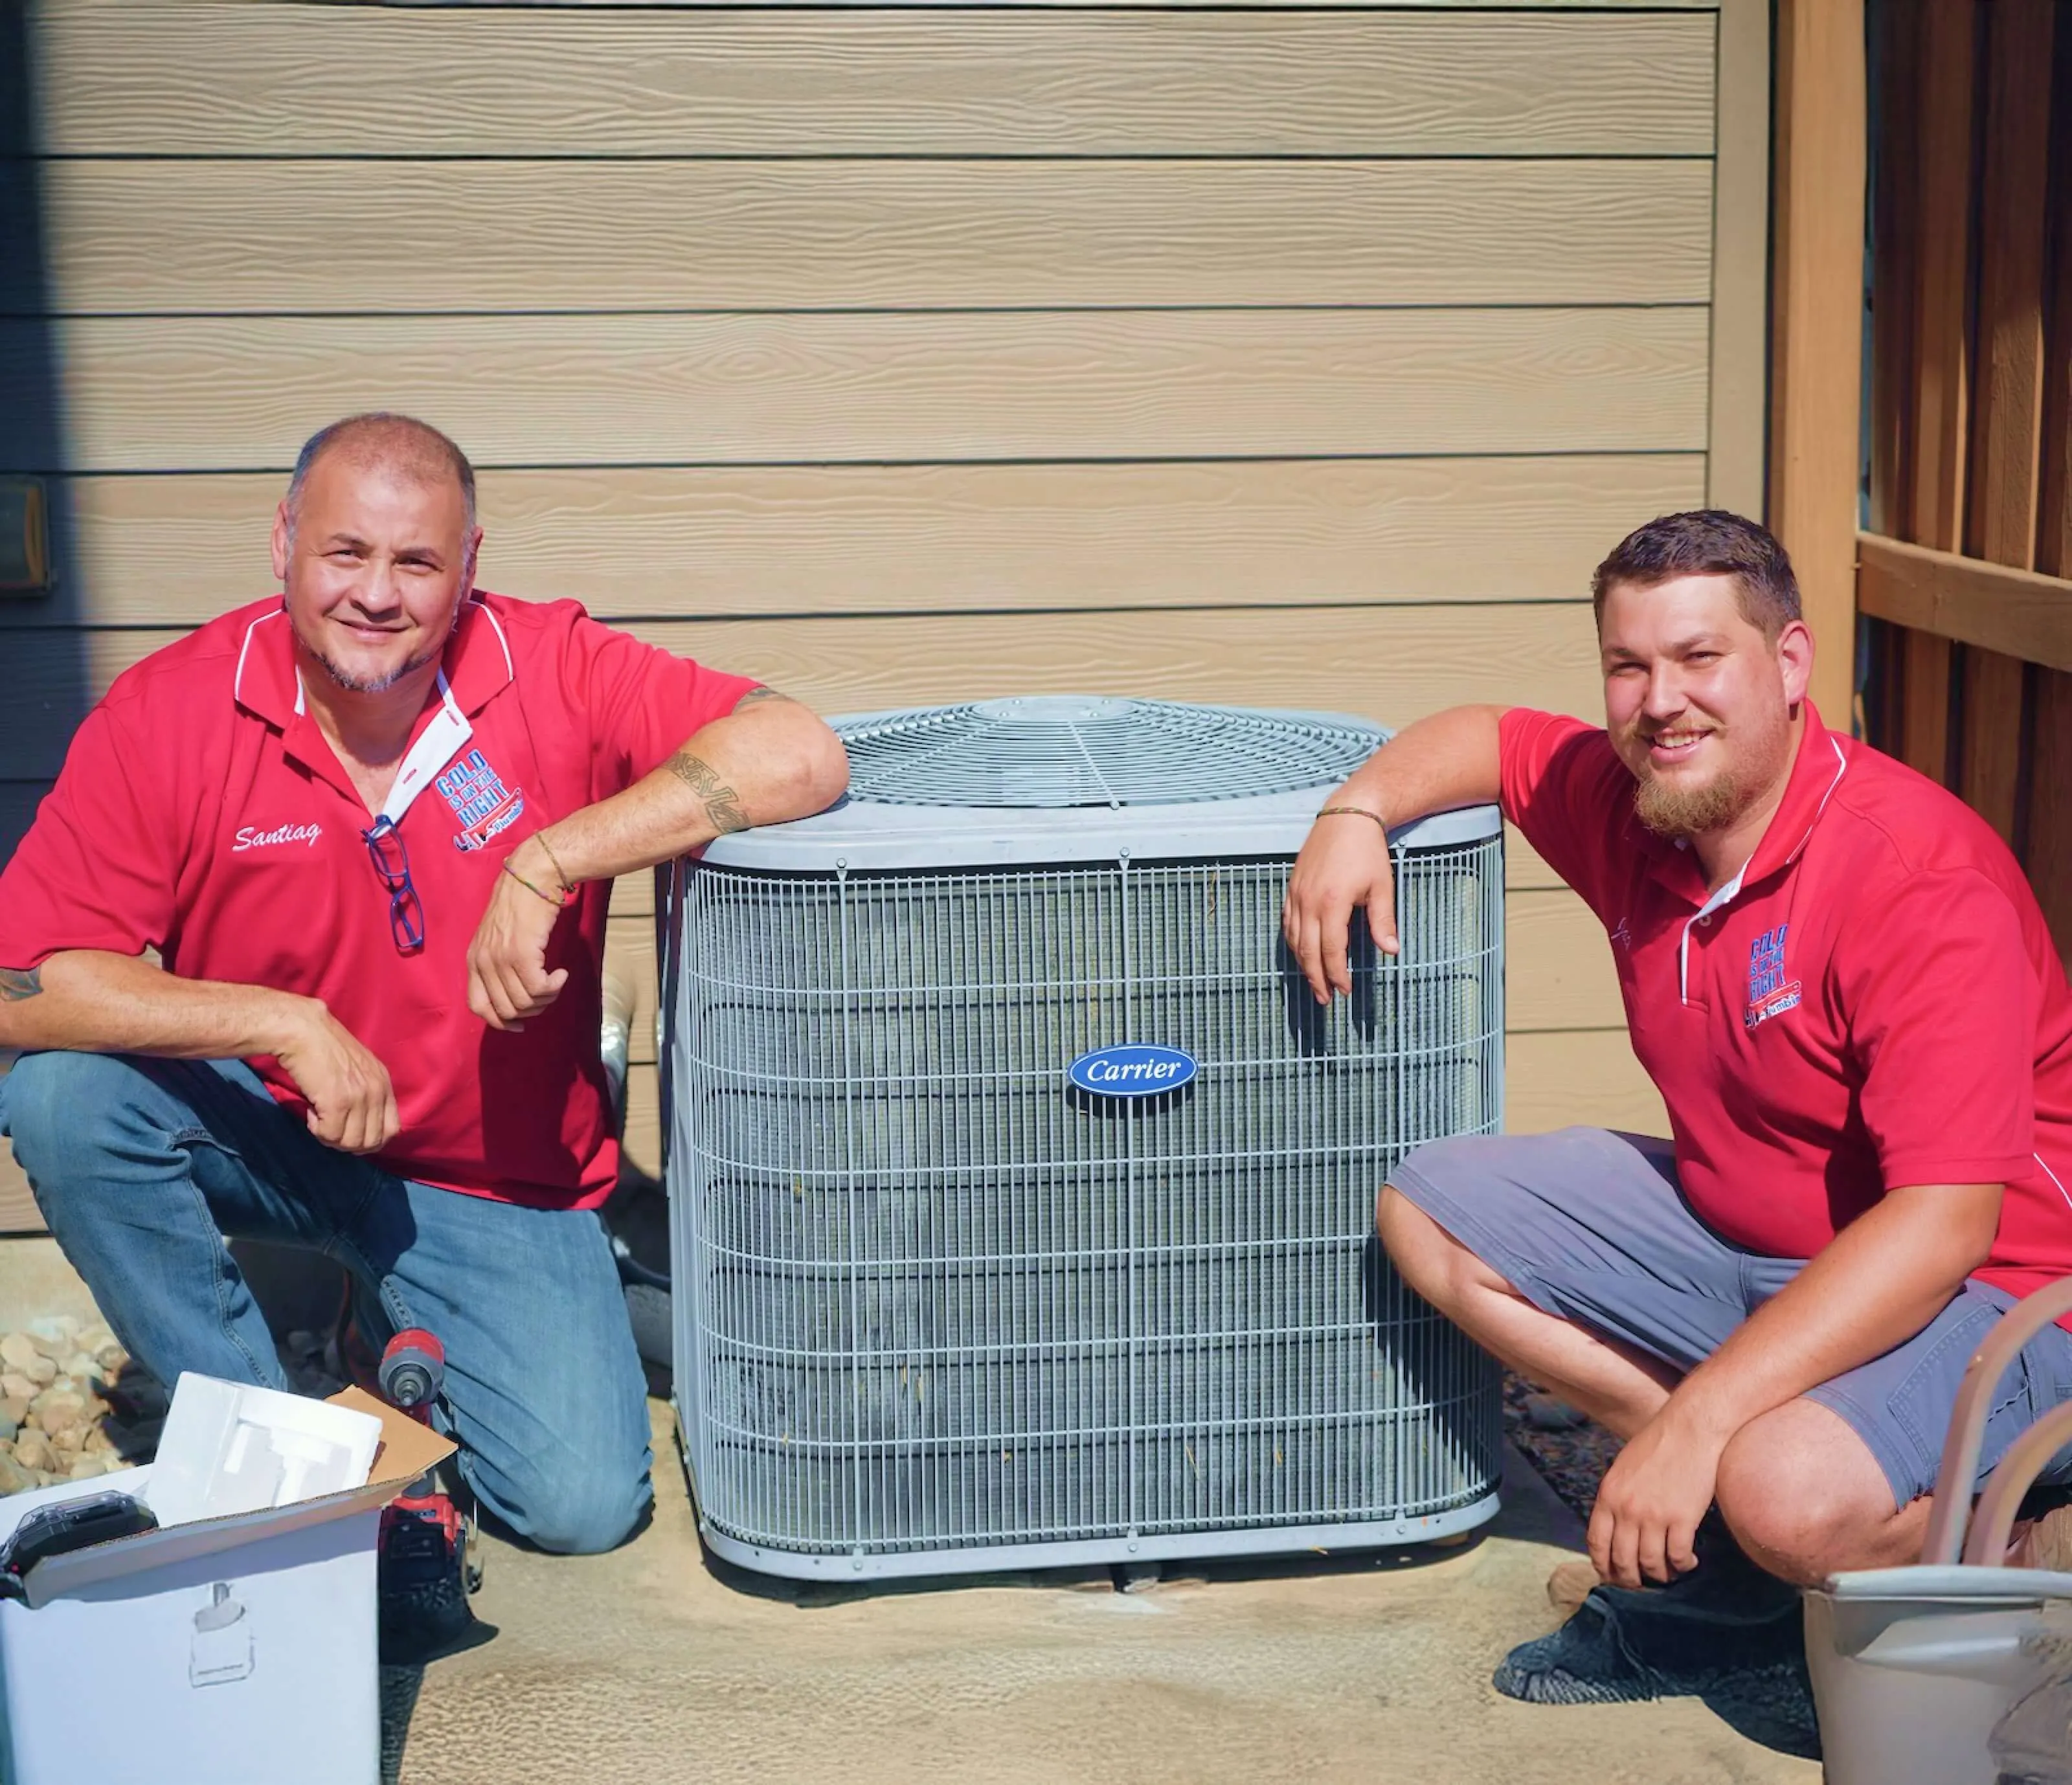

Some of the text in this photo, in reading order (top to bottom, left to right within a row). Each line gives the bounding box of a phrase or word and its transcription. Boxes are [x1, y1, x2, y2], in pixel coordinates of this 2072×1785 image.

[436, 750, 488, 797] COLD
[460, 783, 478, 802] ON
[473, 768, 497, 790] THE
[456, 778, 510, 829] RIGHT
[1751, 924, 1788, 962] COLD
[1087, 1059, 1182, 1081] Carrier
